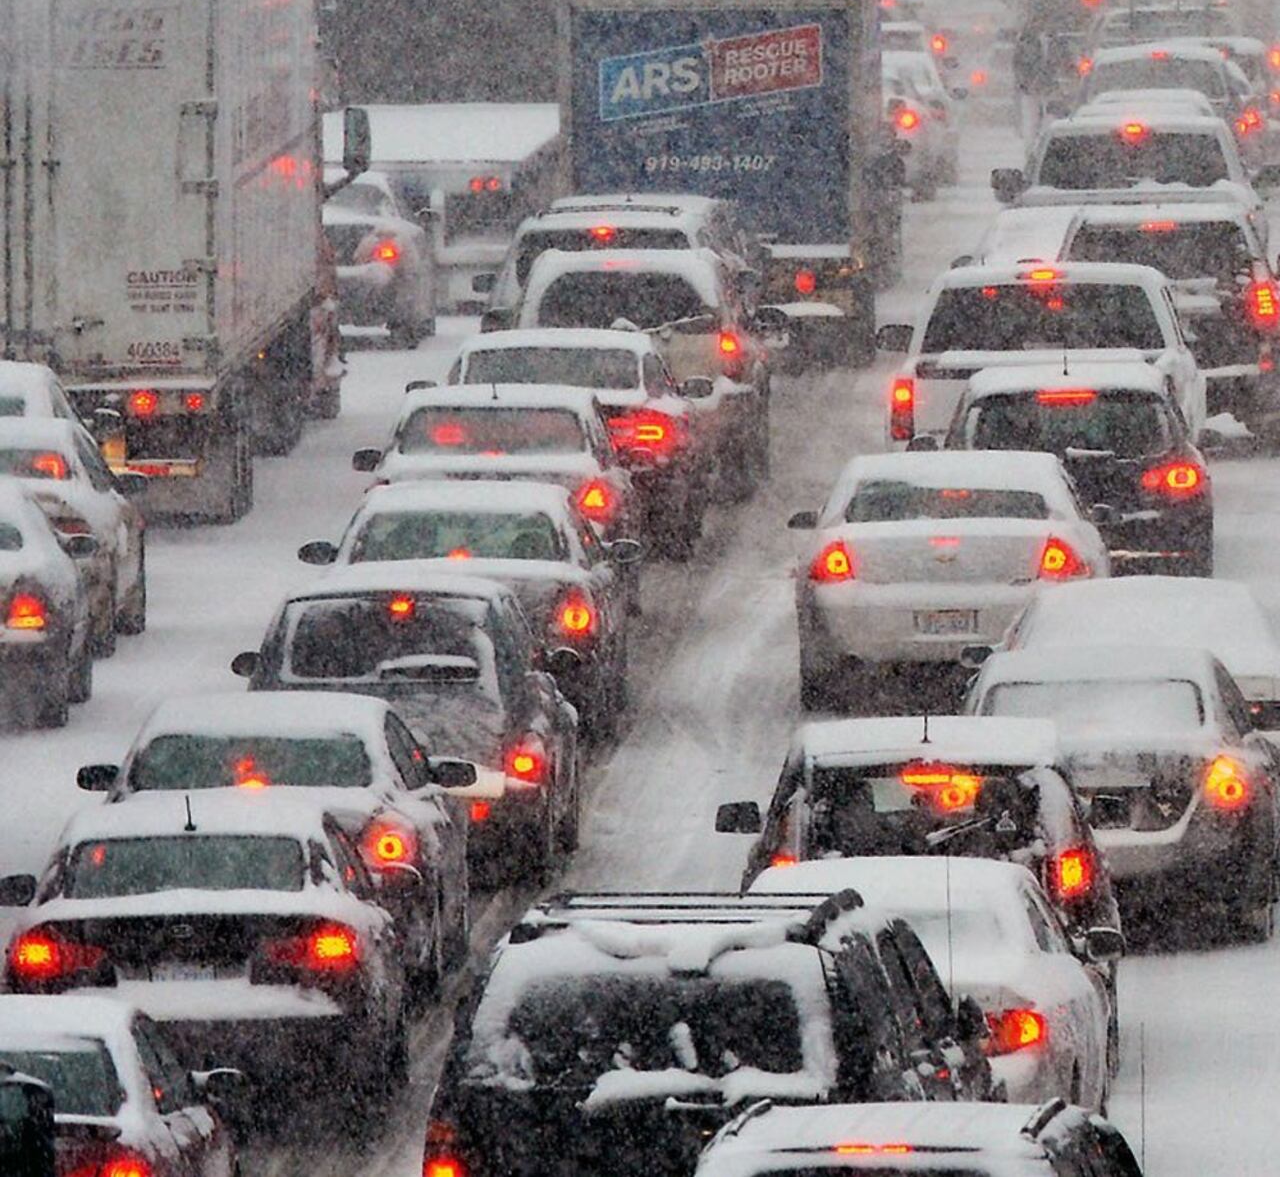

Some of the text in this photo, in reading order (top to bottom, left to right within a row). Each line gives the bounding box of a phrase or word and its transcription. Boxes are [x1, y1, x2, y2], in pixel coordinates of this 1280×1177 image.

[725, 39, 808, 67] RESCUE
[609, 57, 700, 104] ARS
[724, 57, 807, 86] ROOTER
